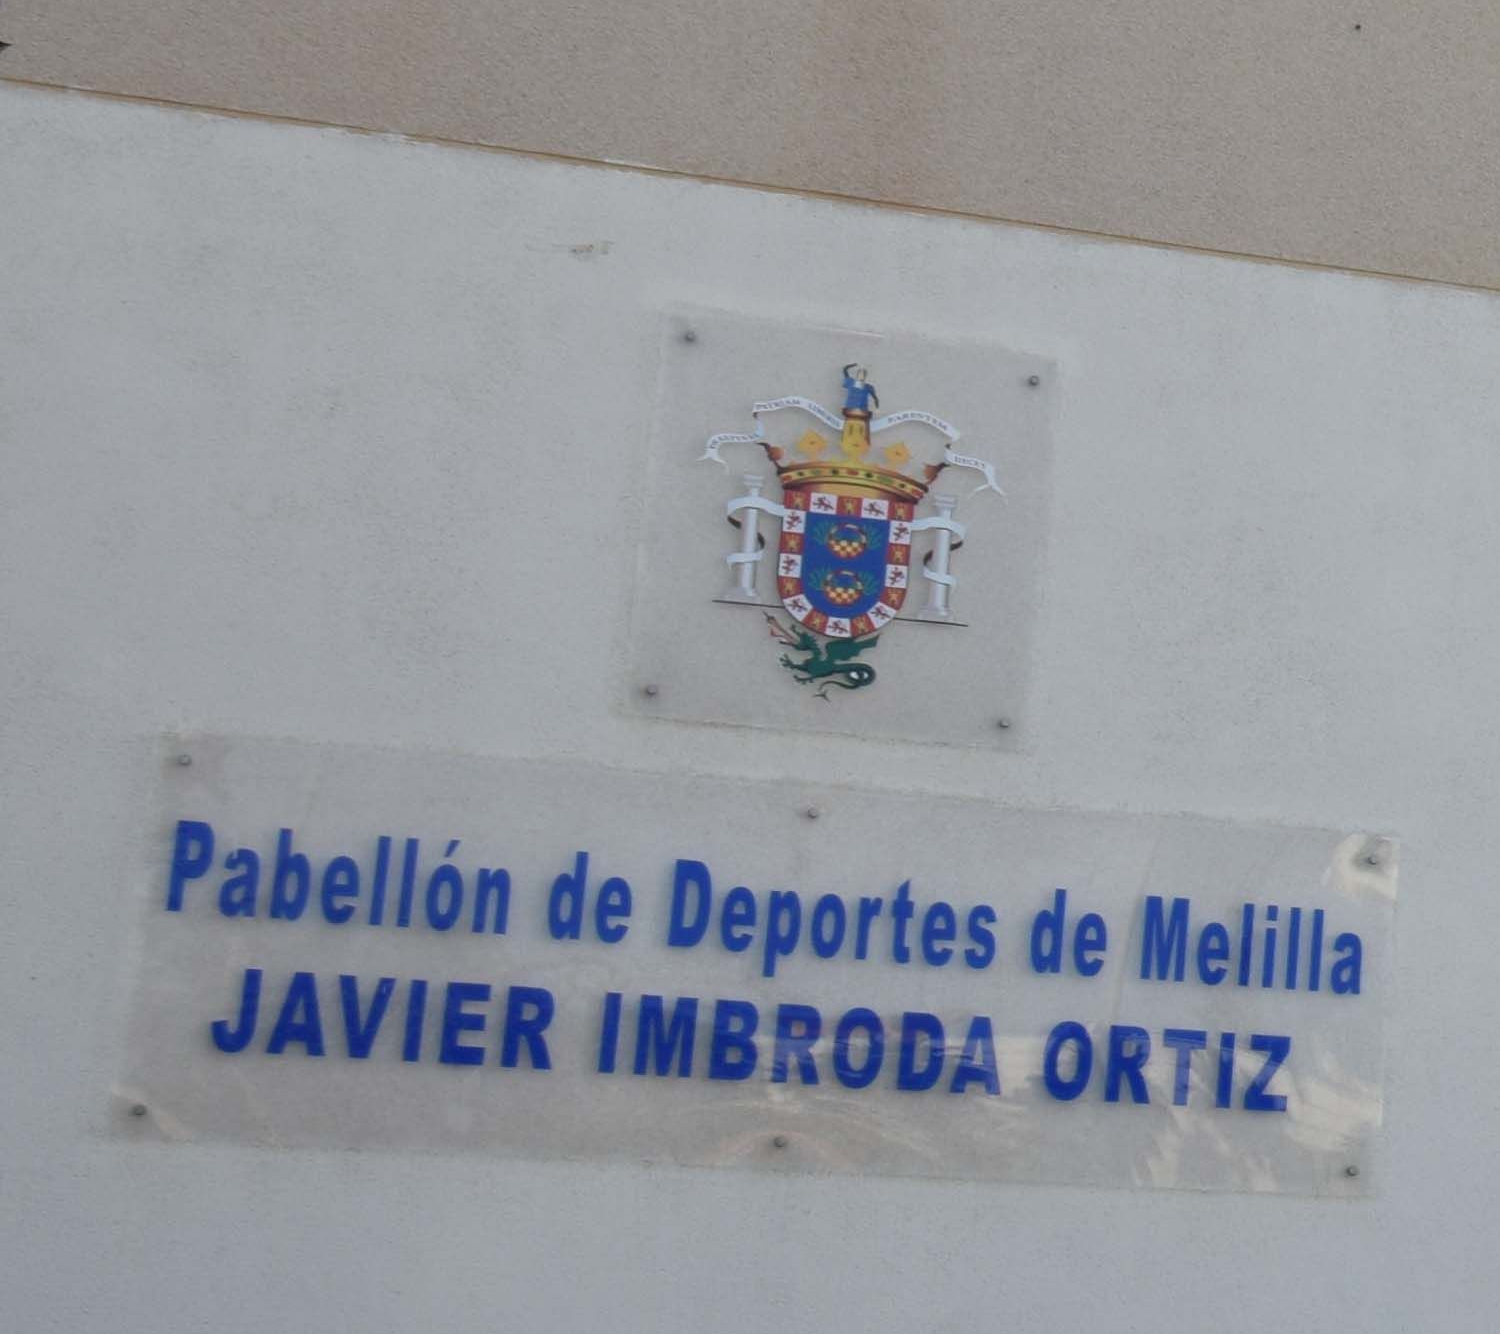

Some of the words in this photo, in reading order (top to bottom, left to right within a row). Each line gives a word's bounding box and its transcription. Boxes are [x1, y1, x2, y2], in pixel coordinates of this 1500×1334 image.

[165, 820, 512, 935] Pabellón
[548, 851, 633, 944] de
[665, 858, 998, 977] Deportes
[1029, 890, 1109, 978] de
[1138, 894, 1364, 996] Melilla
[211, 969, 556, 1072] JAVIER
[597, 992, 1002, 1096] IMBRODA
[1042, 1020, 1293, 1114] ORTIZ
